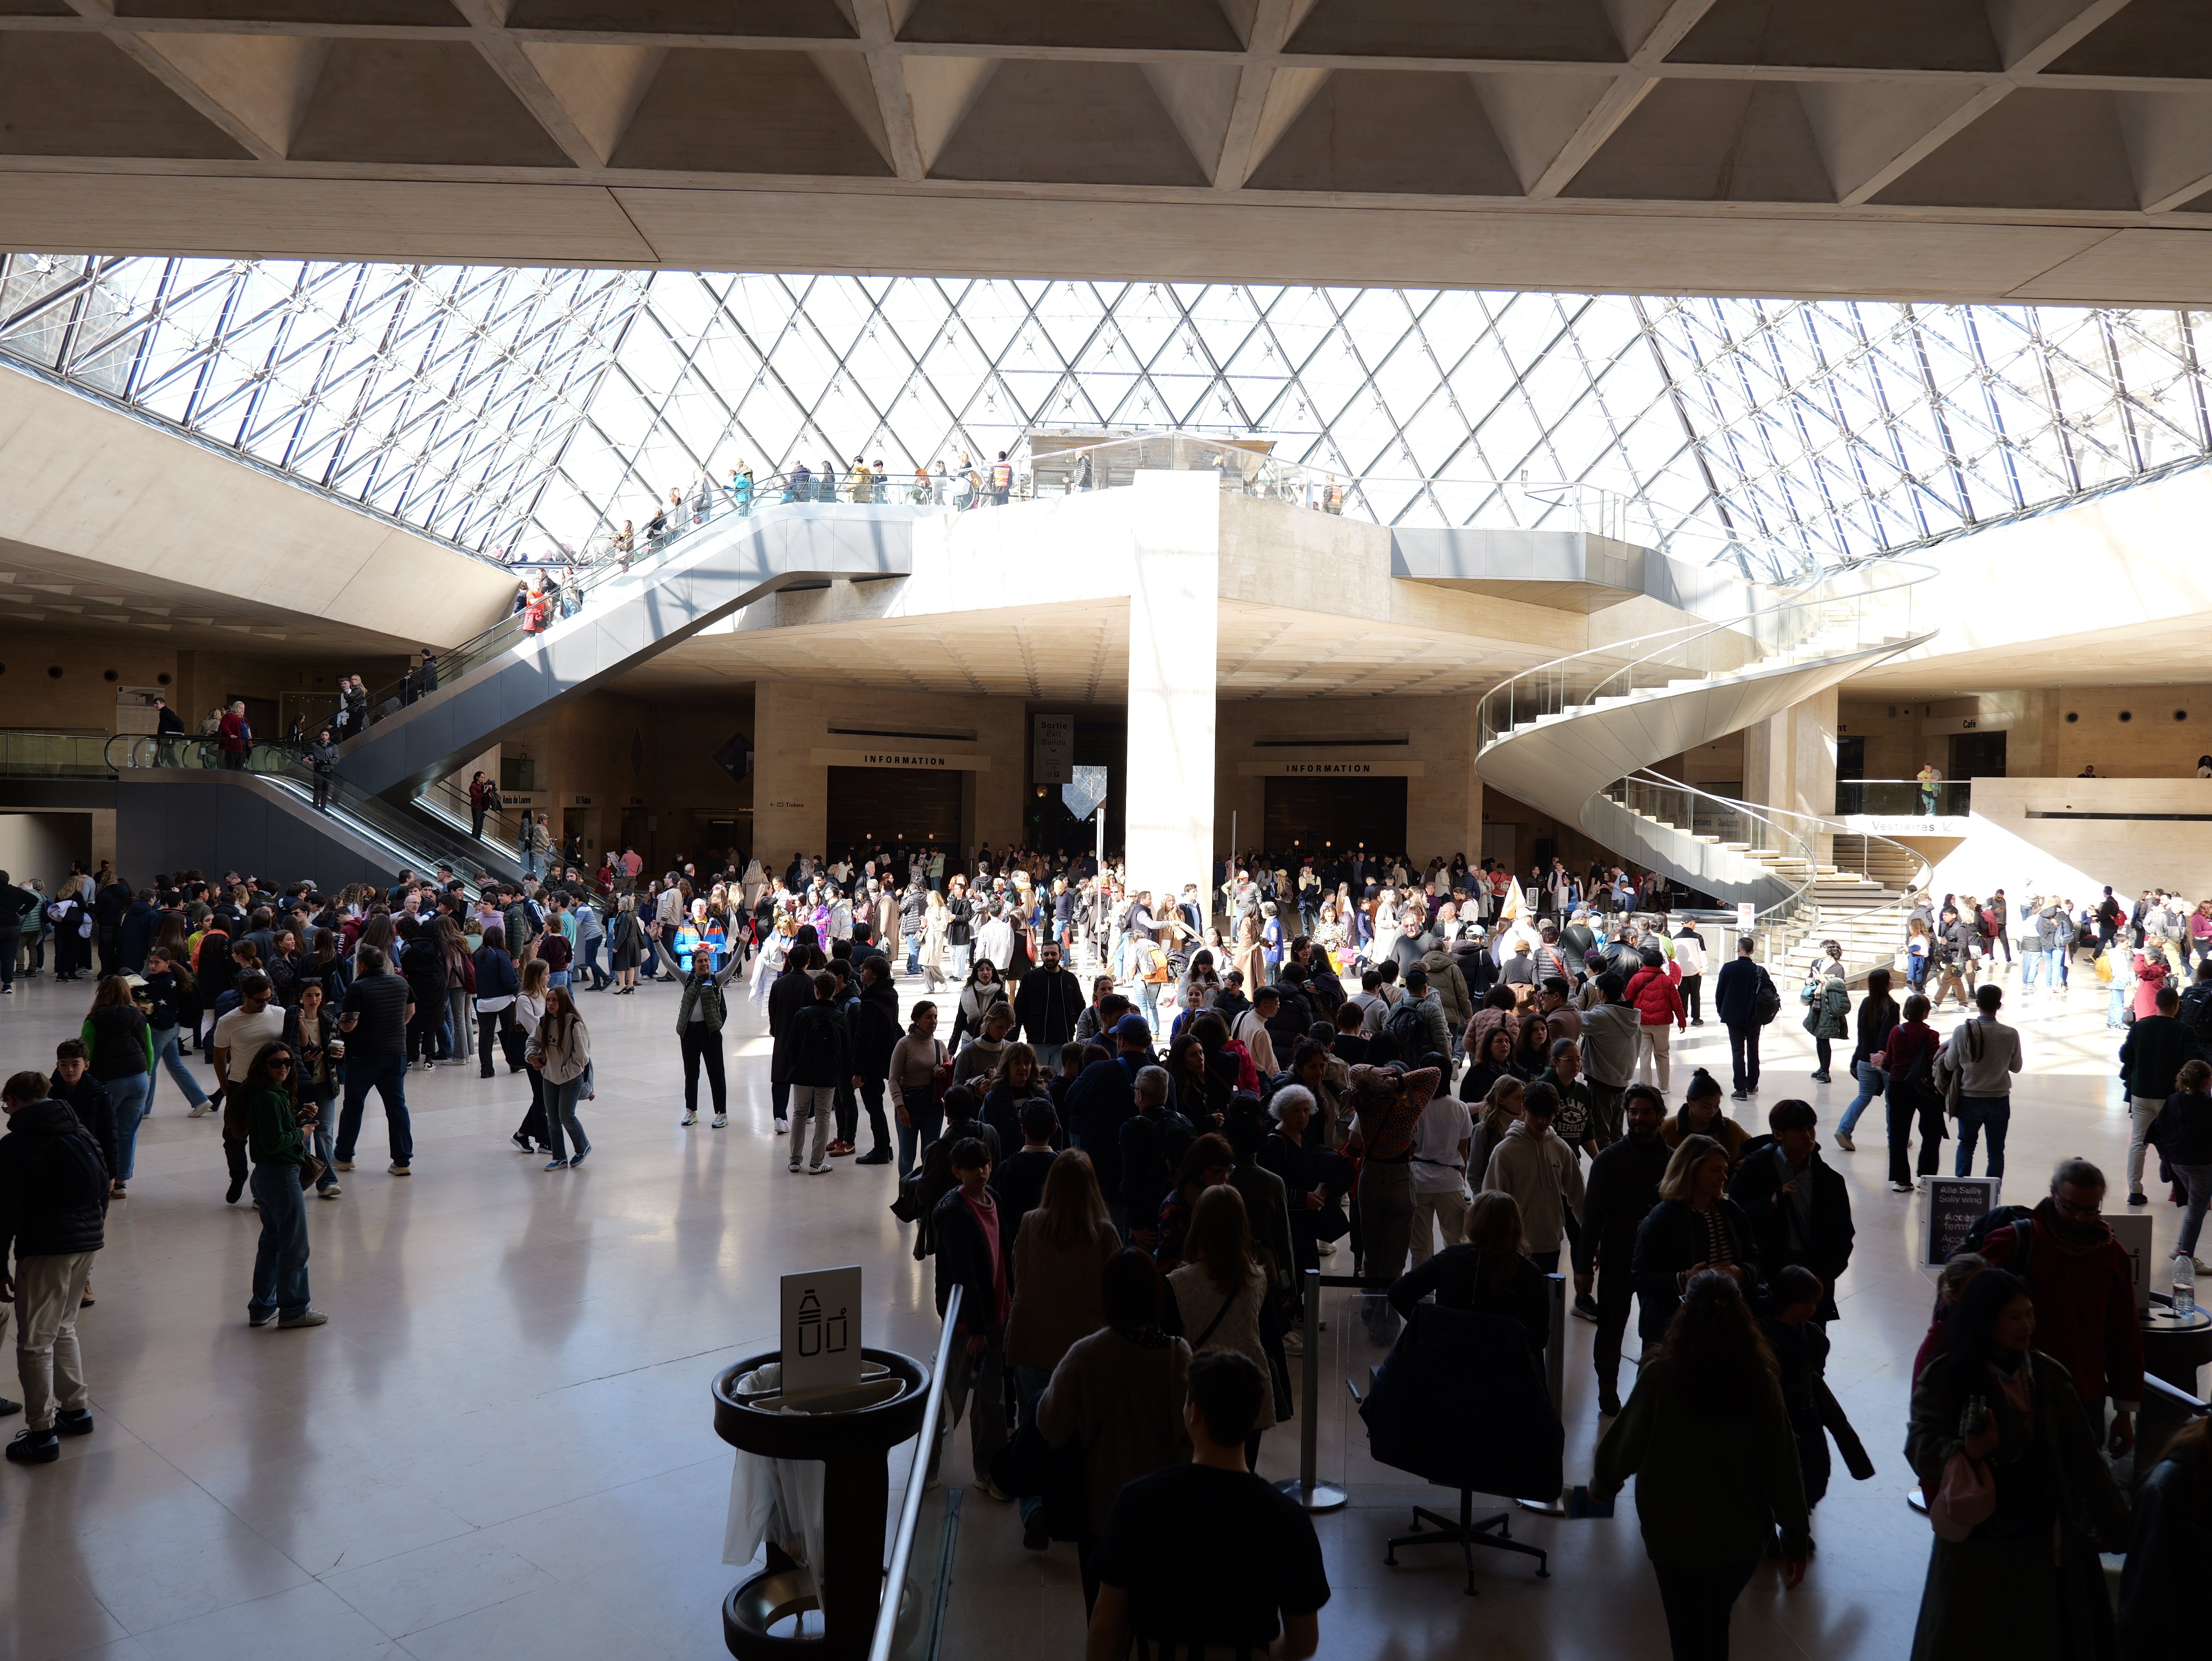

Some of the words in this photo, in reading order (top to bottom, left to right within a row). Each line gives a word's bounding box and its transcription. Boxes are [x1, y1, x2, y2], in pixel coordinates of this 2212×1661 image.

[1963, 719, 1976, 728] Café
[864, 755, 945, 765] INFORMATION
[502, 795, 512, 804] Amis
[513, 795, 518, 804] du
[519, 795, 531, 804] Louvre
[1693, 817, 1711, 826] estiaires
[1718, 818, 1740, 827] Cloakroom
[1872, 821, 1935, 831] Vestiaires
[1940, 1186, 1957, 1194] Aile
[1960, 1186, 1982, 1196] Sully
[1939, 1195, 1960, 1204] Sully
[1961, 1196, 1982, 1205] wing
[1944, 1212, 1976, 1222] Accès
